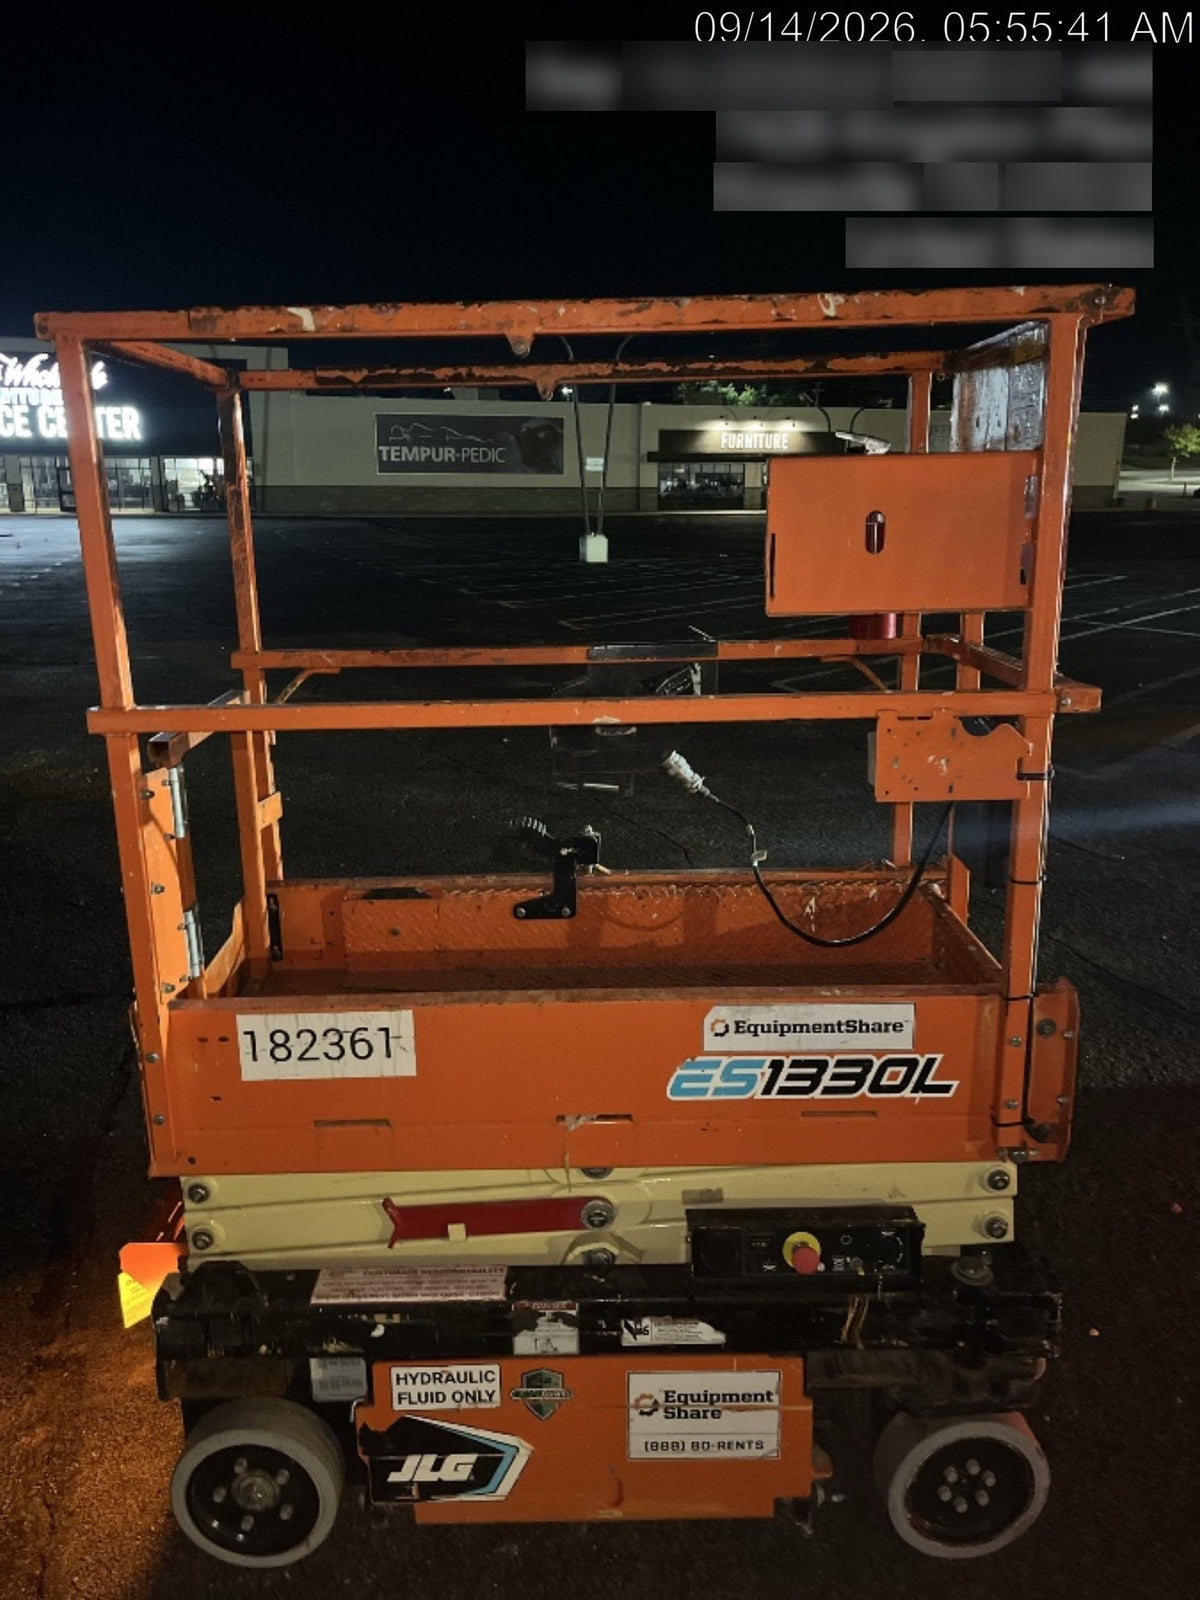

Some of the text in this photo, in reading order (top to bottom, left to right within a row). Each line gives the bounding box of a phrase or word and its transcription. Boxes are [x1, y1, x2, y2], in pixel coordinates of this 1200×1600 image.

[37, 406, 142, 440] CETER
[720, 433, 789, 449] FURNITURE
[378, 446, 506, 463] TEMPUR-PEDIC
[733, 1020, 904, 1036] EquipmentShare
[243, 1027, 392, 1062] 182361
[669, 1056, 956, 1098] ES1330L
[395, 1370, 496, 1386] HYDRAULIC
[397, 1391, 446, 1405] FLUID
[451, 1390, 496, 1404] ONLY
[664, 1390, 774, 1405] Equipment
[664, 1407, 722, 1419] Share
[644, 1441, 685, 1452] (888)
[387, 1454, 478, 1482] JLG
